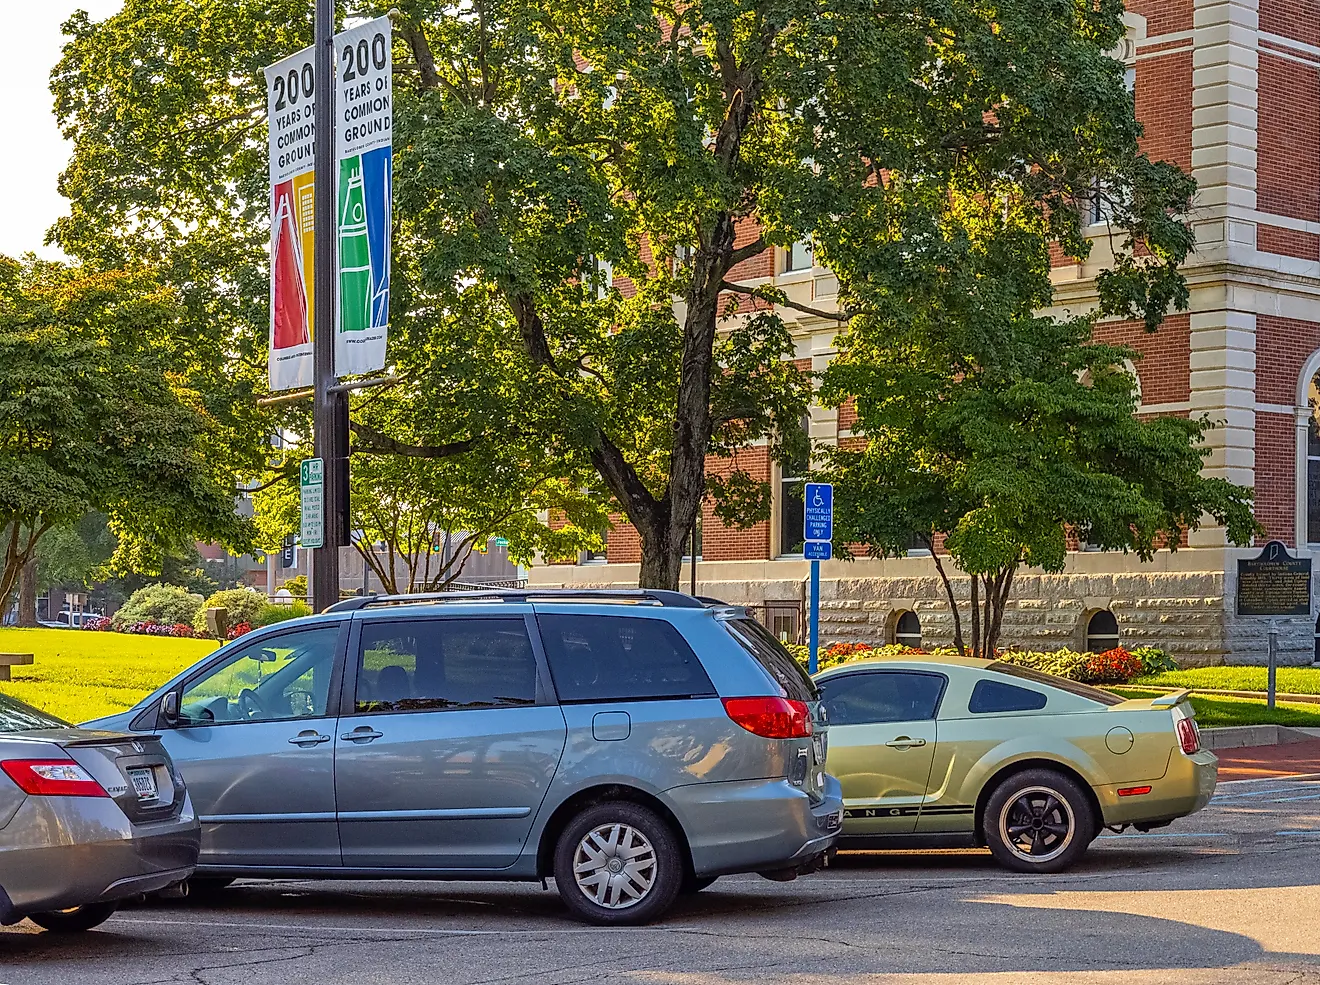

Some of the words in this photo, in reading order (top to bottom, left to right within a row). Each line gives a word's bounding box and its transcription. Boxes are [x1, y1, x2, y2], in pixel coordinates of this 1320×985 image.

[342, 33, 386, 83] 200
[273, 63, 315, 112] 200
[344, 81, 371, 103] YEARS
[375, 75, 388, 91] OF
[276, 108, 301, 131] YEARS
[344, 95, 390, 122] COMMON
[344, 116, 391, 142] GROUND
[303, 465, 308, 481] 3
